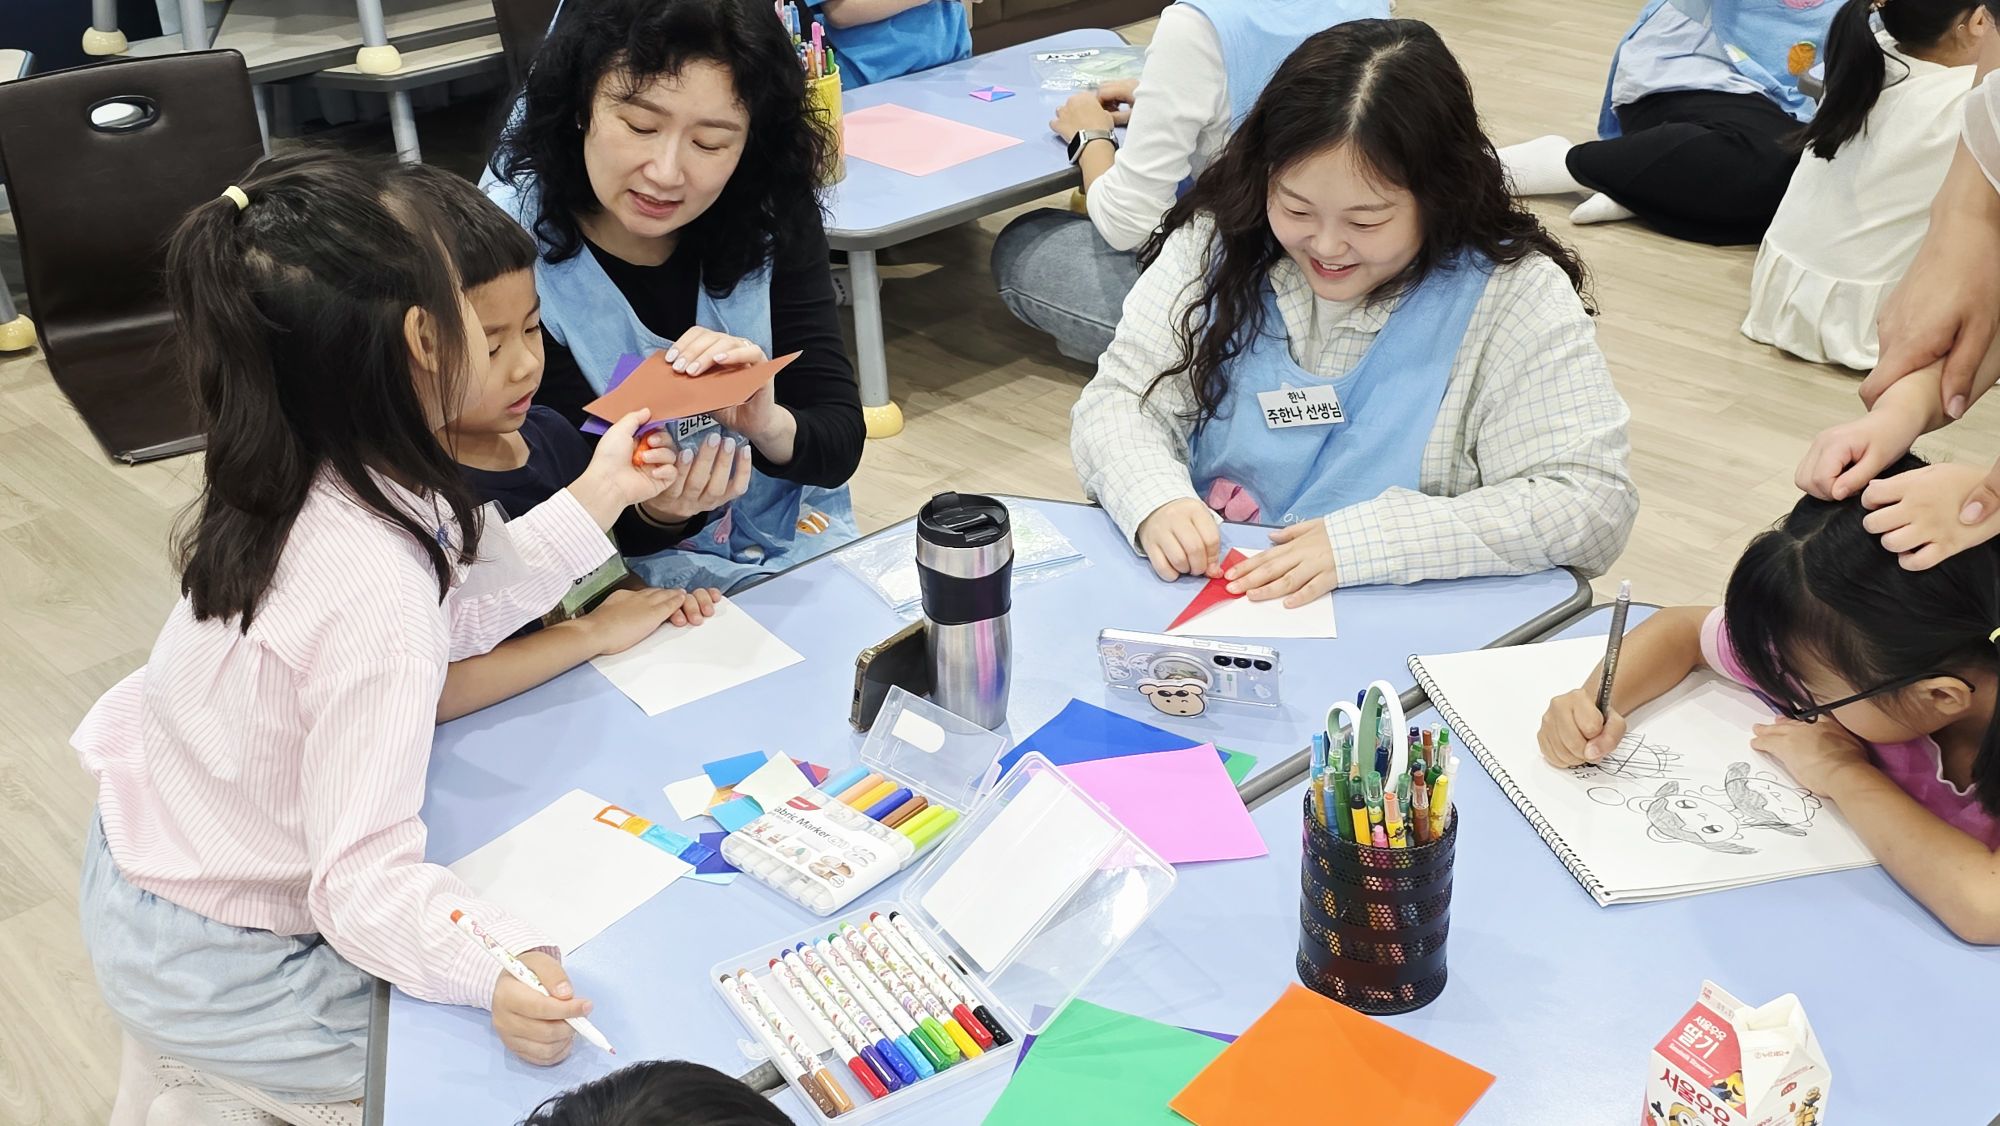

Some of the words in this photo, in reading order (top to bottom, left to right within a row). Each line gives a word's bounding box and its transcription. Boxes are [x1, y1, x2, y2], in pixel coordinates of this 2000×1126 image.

[1287, 391, 1307, 403] 한나
[1267, 406, 1303, 425] 주한나
[1306, 402, 1342, 420] 선생님
[773, 807, 798, 821] abric
[797, 818, 831, 839] Marker
[1678, 1023, 1719, 1059] 딸기
[1693, 1016, 1727, 1041] 서울우유
[1660, 1067, 1730, 1126] 서울우유
